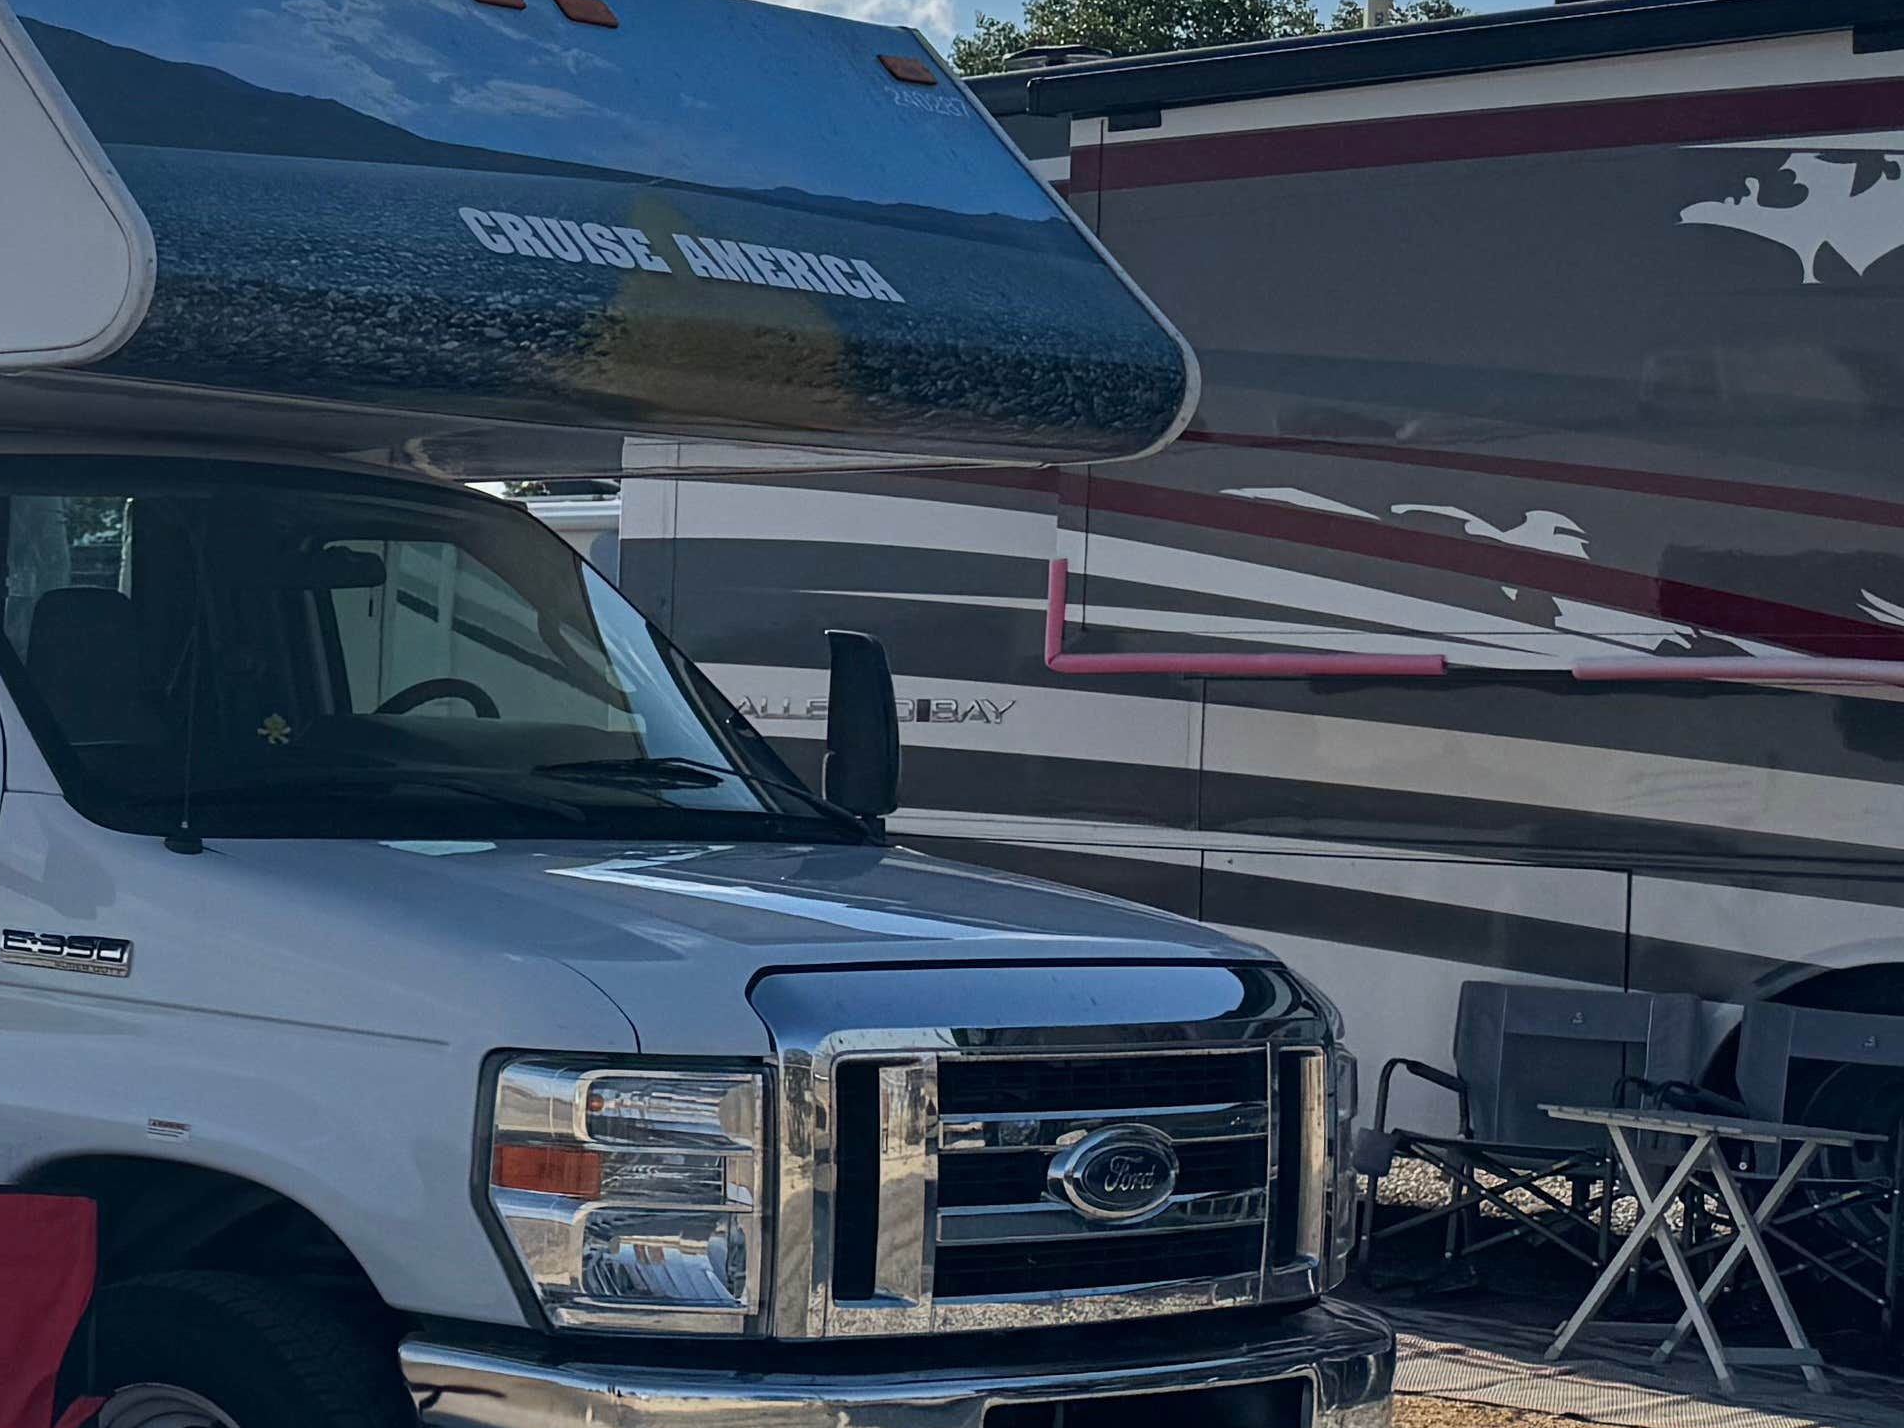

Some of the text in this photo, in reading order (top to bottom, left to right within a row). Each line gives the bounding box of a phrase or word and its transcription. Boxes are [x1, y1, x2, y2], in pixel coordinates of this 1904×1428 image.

[458, 207, 905, 303] CRUISE AMERICA
[930, 698, 1017, 724] BAY
[1104, 1155, 1156, 1192] Ford
